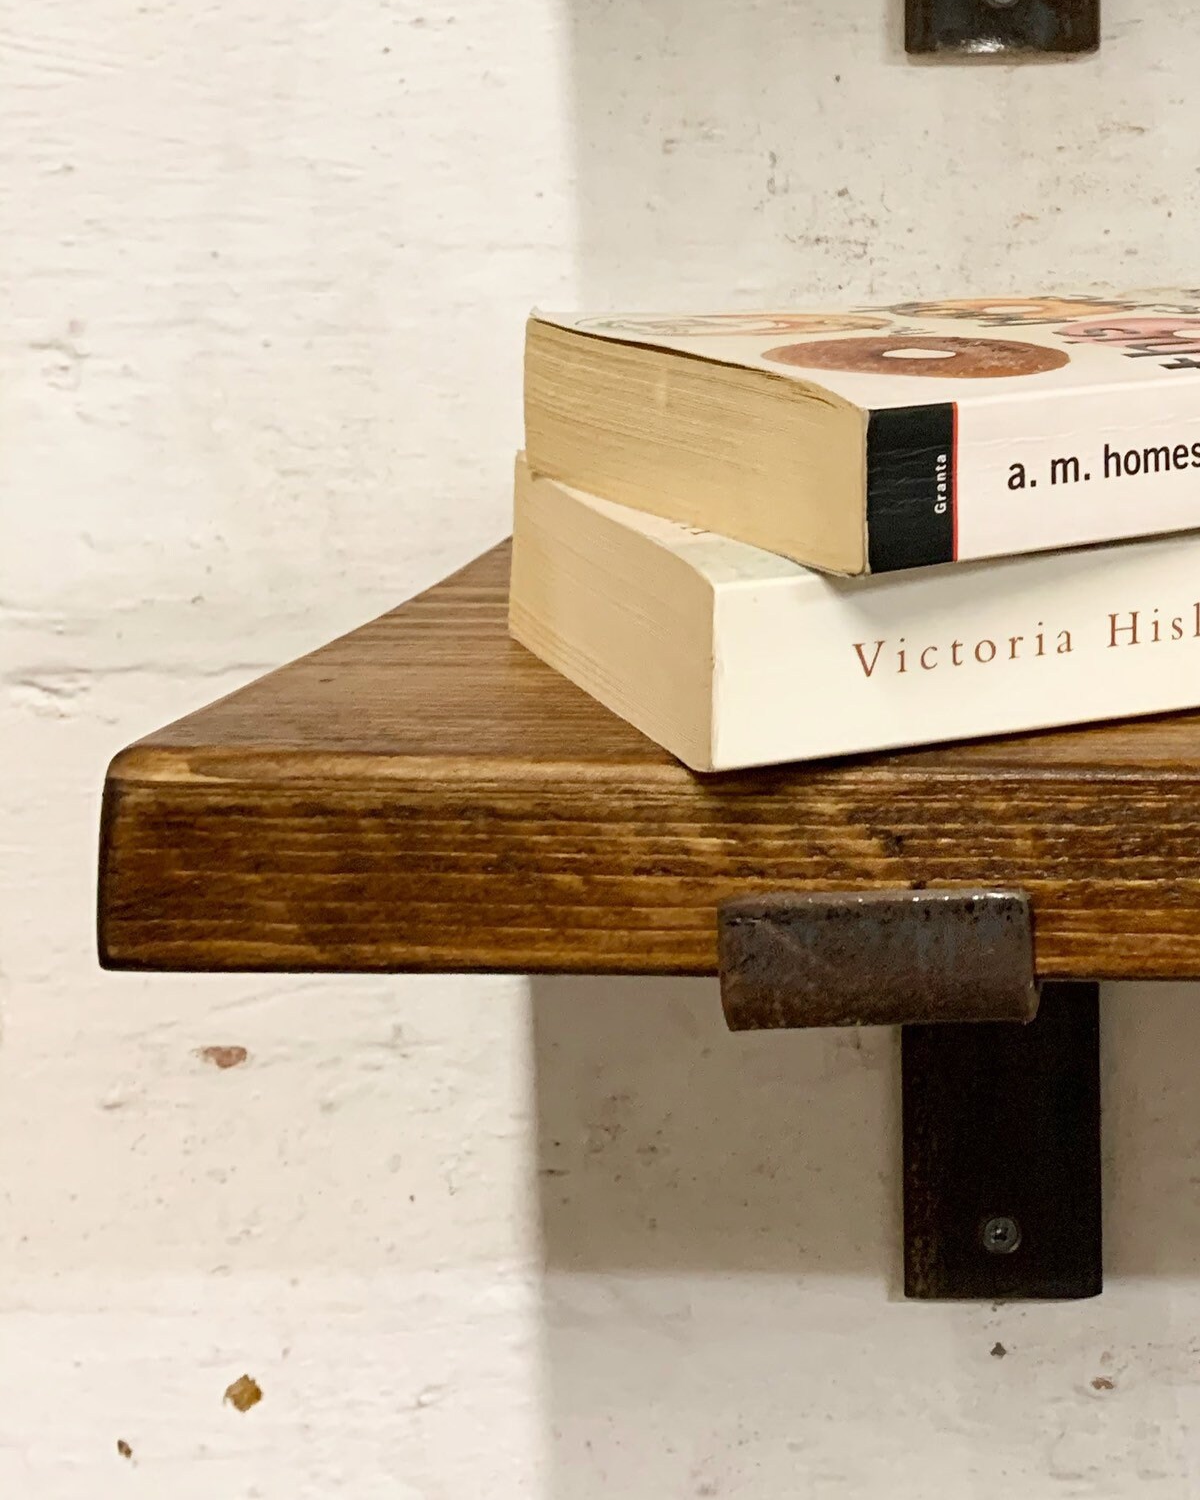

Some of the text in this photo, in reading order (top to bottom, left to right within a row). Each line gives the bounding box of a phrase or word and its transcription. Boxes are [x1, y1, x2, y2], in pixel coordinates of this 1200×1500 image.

[934, 453, 948, 515] Granta
[1006, 462, 1038, 491] a.
[1050, 454, 1091, 486] m.
[851, 620, 1075, 679] Victoria
